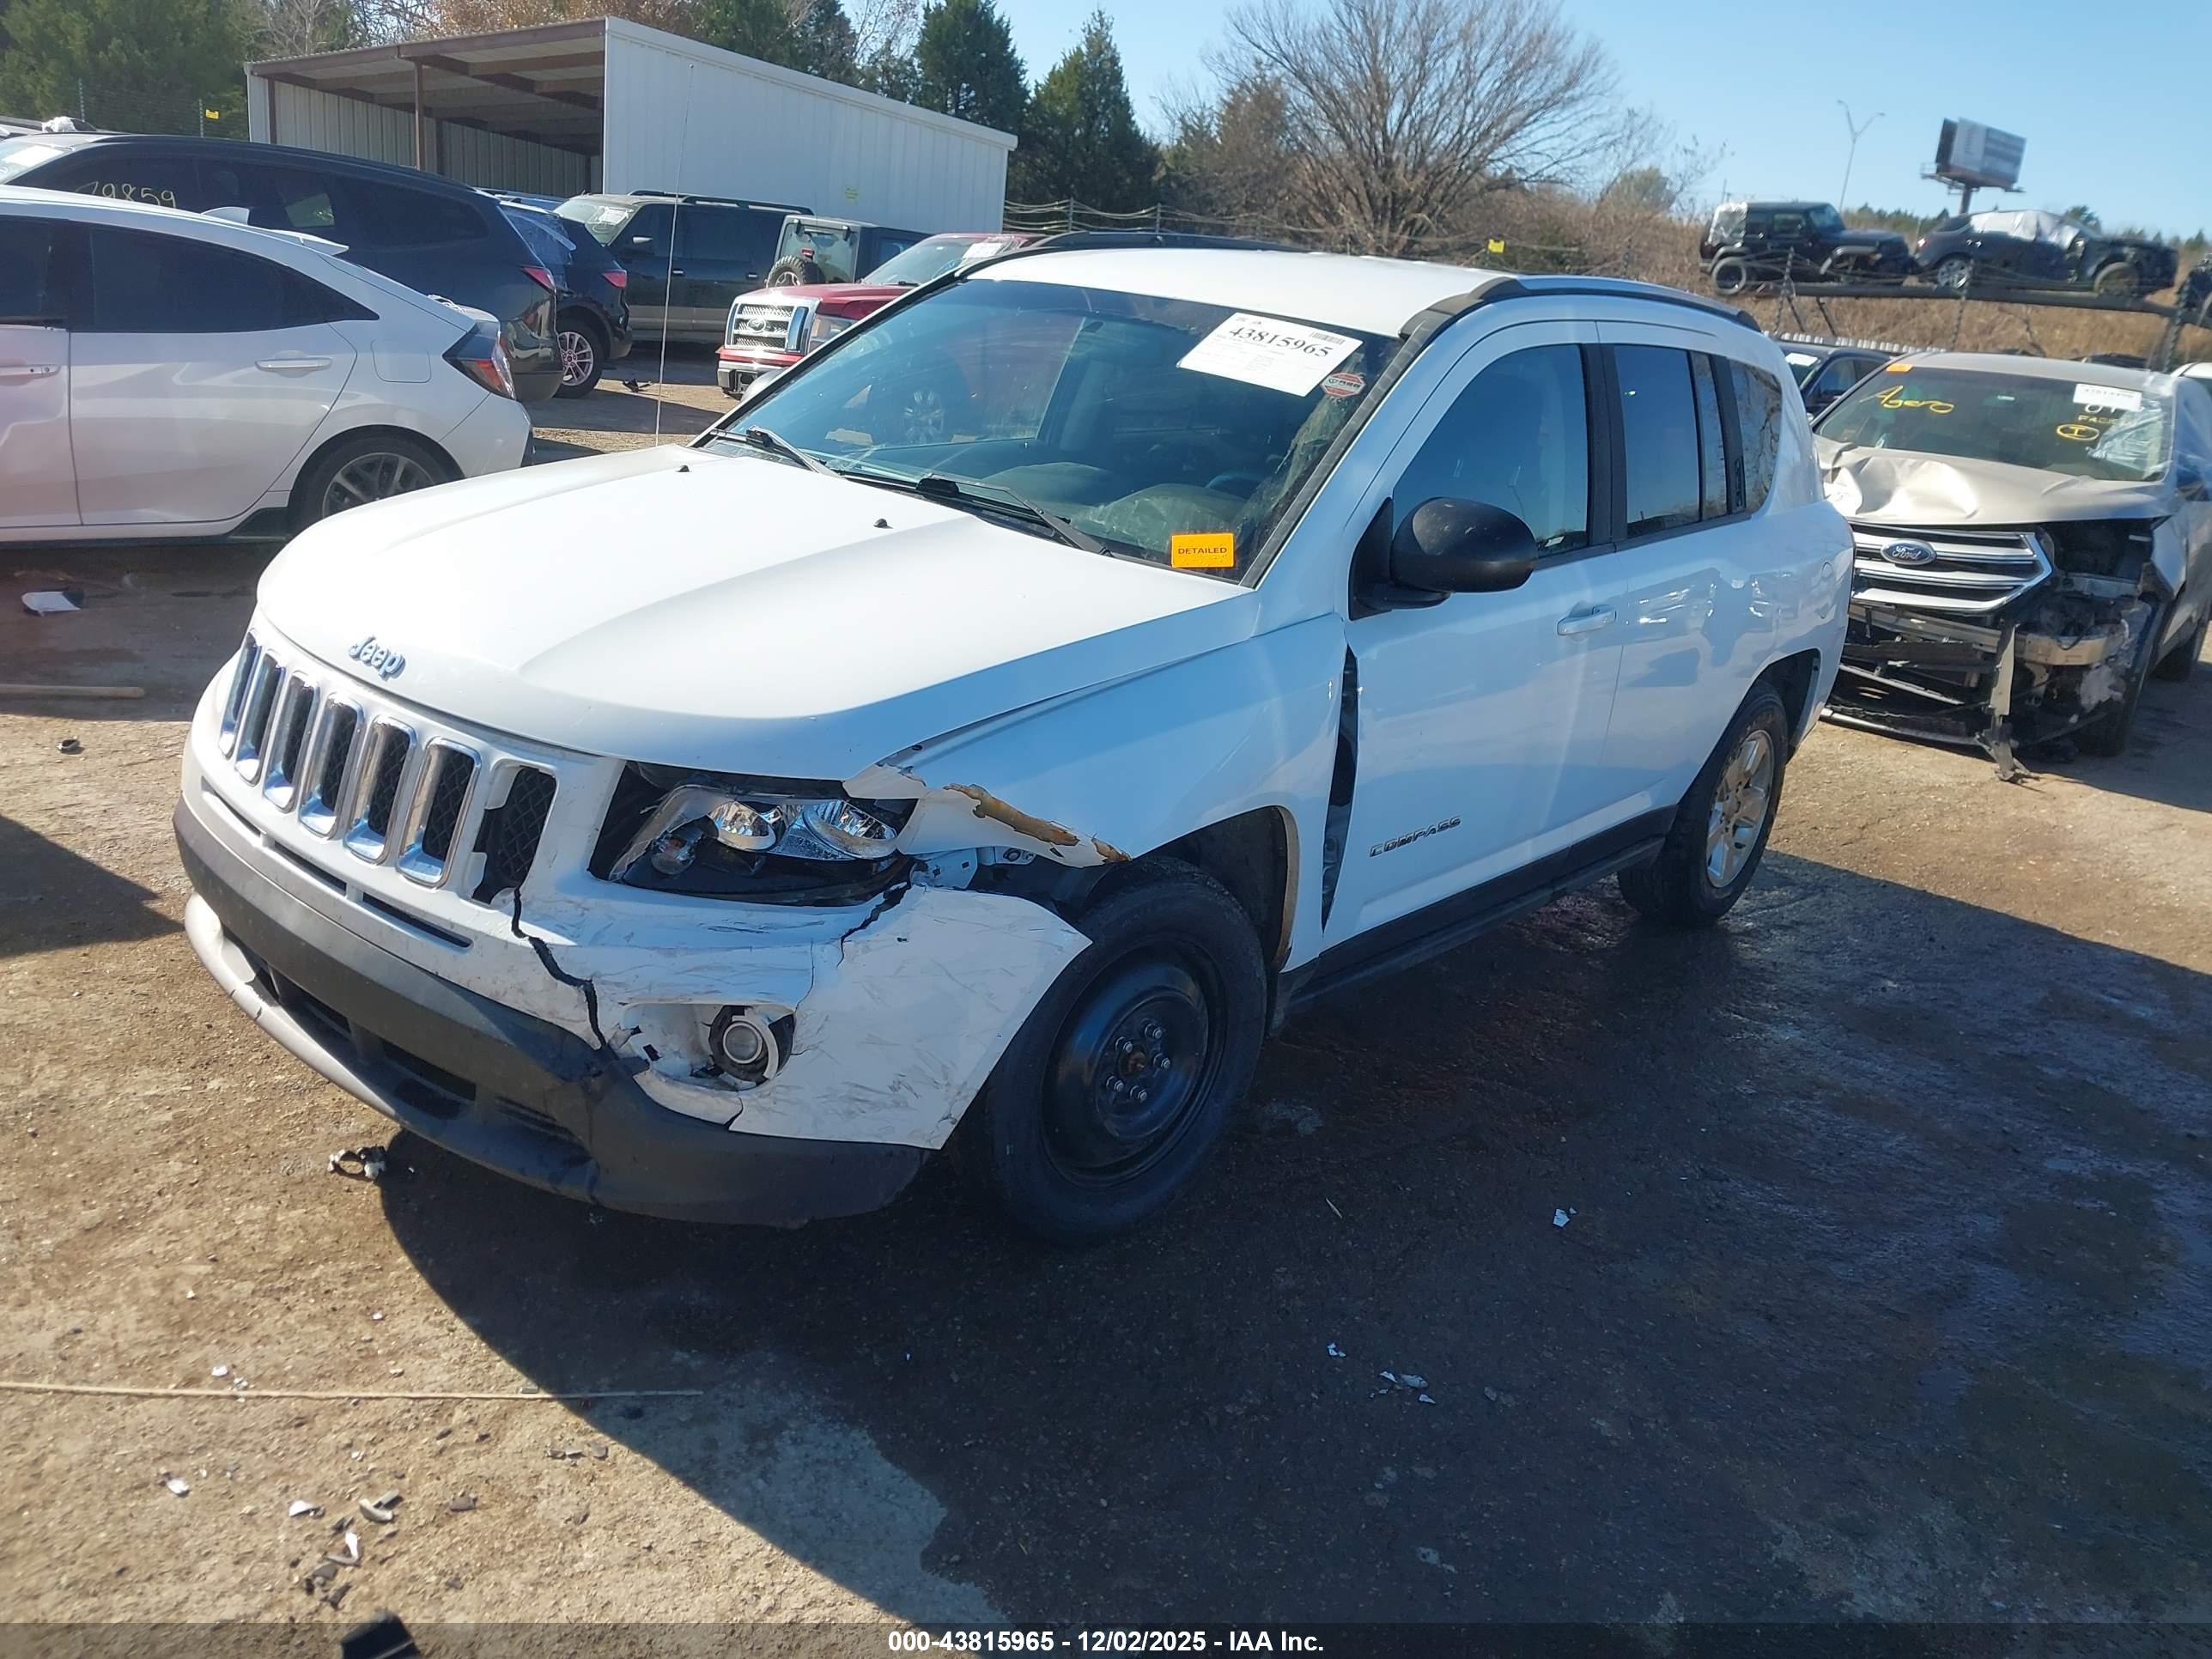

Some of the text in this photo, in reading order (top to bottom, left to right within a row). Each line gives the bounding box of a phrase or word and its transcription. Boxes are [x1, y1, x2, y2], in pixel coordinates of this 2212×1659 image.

[1229, 325, 1334, 358] 43815965
[1892, 546, 1922, 561] Ford
[349, 635, 406, 681] Jeep
[1370, 815, 1462, 857] COMPASS
